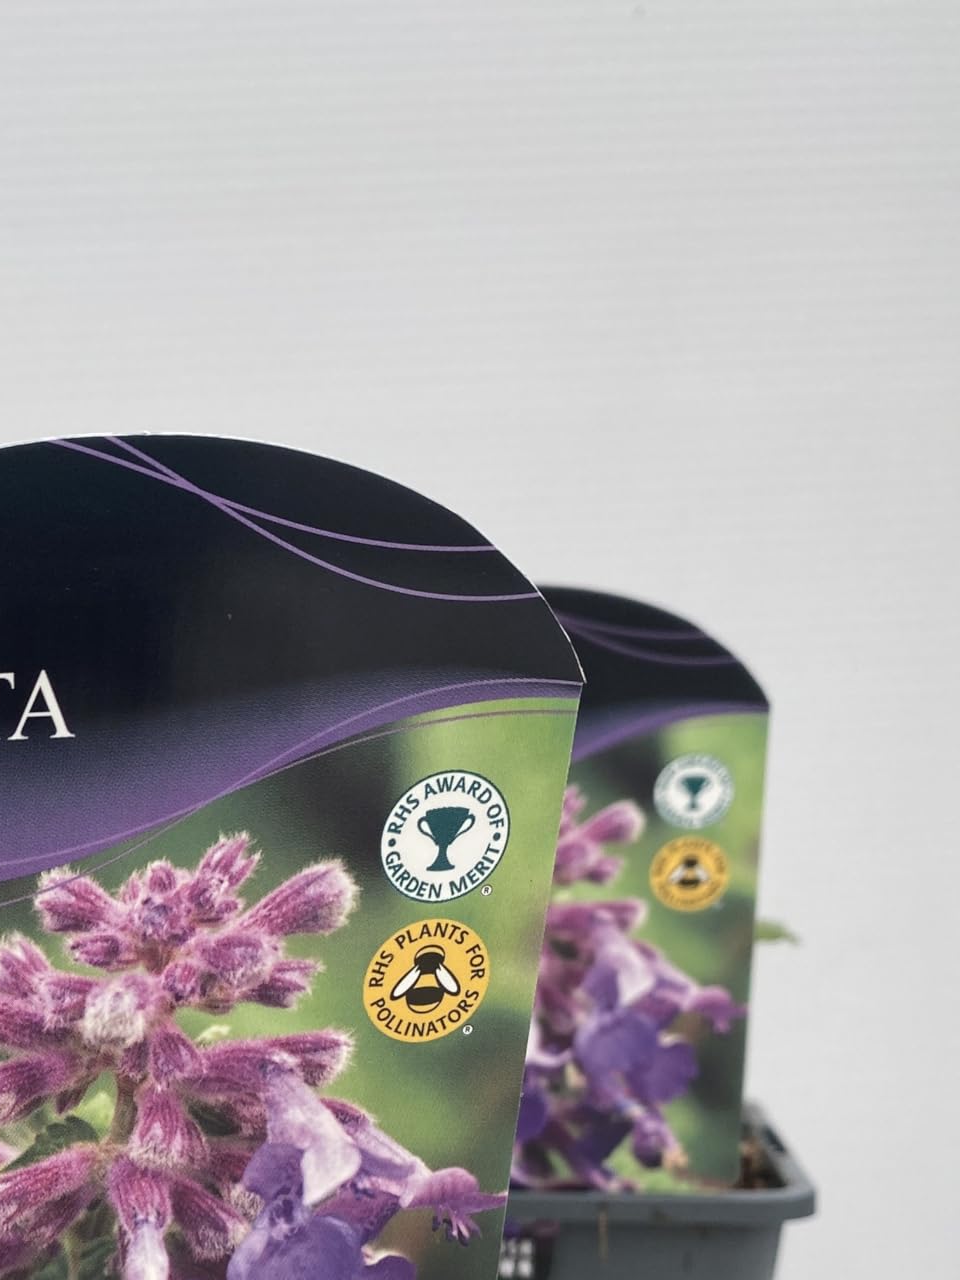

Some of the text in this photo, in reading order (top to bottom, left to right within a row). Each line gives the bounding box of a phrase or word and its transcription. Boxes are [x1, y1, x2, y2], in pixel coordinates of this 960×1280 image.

[388, 776, 504, 835] RHS AWARD OF
[385, 844, 500, 899] GARDEN MERIT
[368, 922, 486, 988] RHS PLANTS FOR
[370, 989, 479, 1037] POLLINATORS
